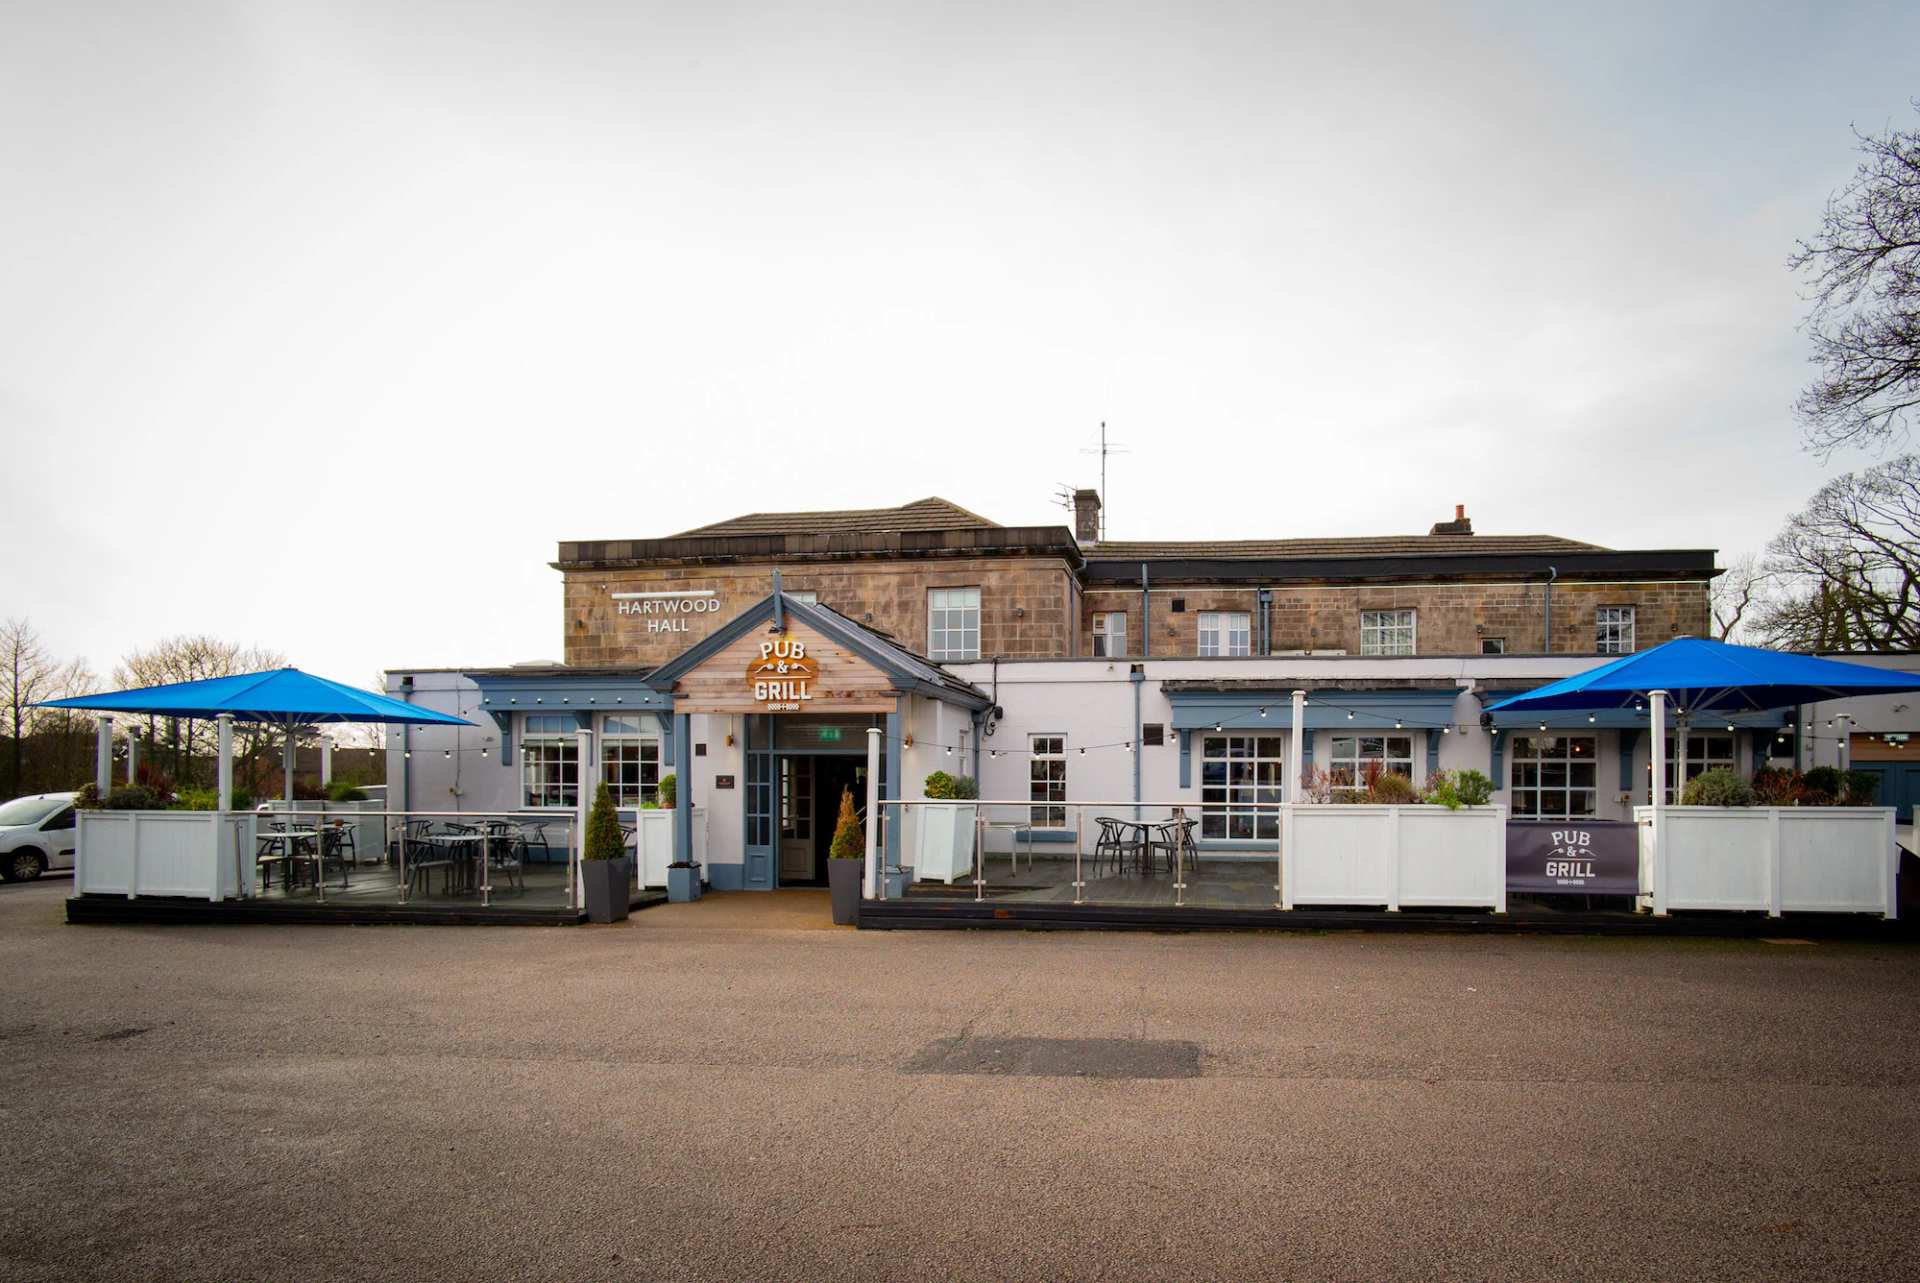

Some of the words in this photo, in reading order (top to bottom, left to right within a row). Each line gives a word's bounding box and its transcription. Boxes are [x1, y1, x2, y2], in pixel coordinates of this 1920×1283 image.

[618, 598, 720, 615] HARTWOOD
[648, 618, 689, 633] HALL
[760, 640, 806, 660] PUB
[777, 660, 789, 674] &
[755, 681, 812, 701] GRILL
[1551, 830, 1591, 846] PUB
[1566, 846, 1577, 857] &
[1546, 862, 1596, 877] GRILL
